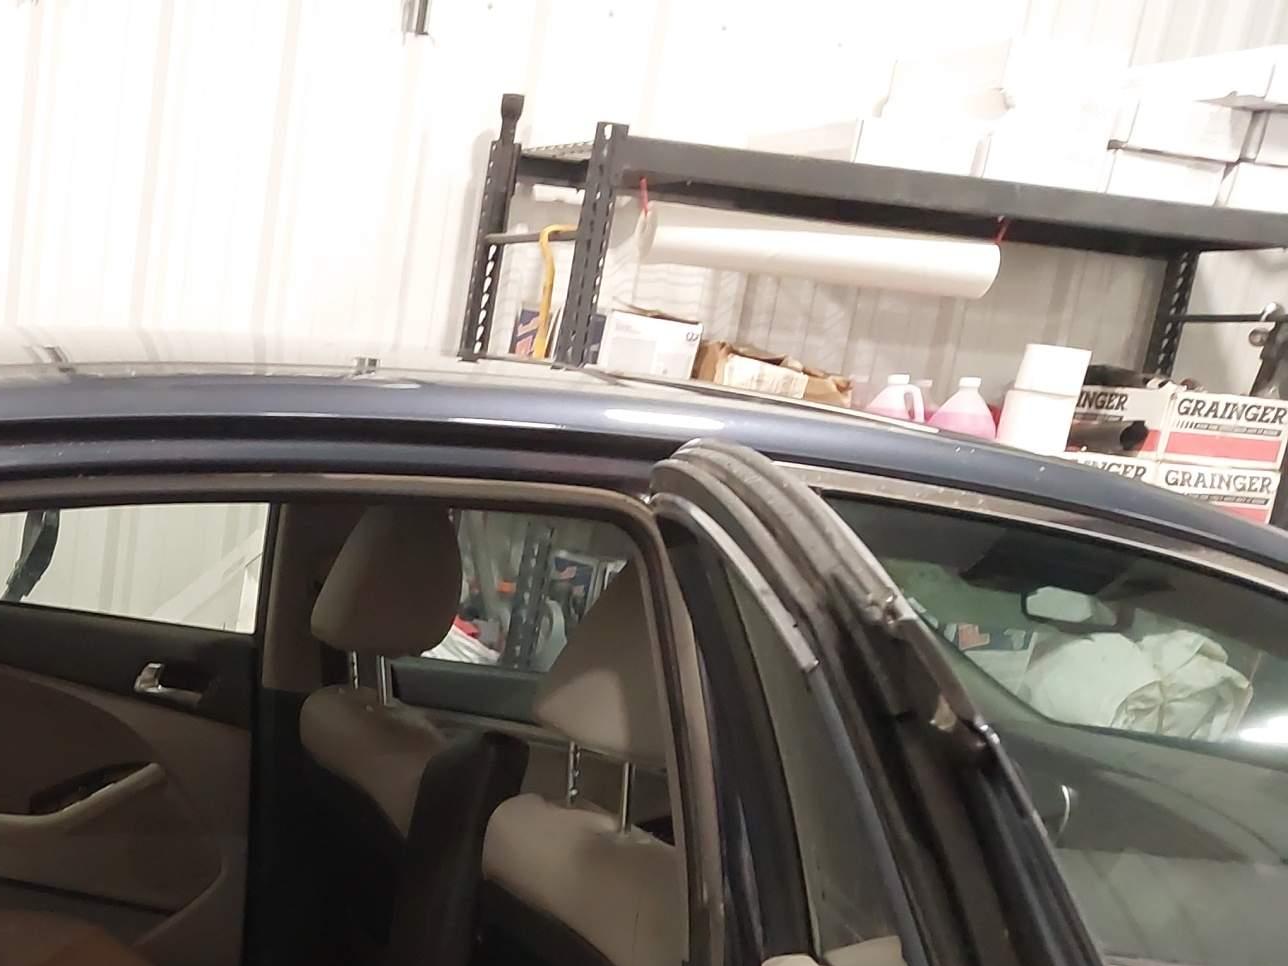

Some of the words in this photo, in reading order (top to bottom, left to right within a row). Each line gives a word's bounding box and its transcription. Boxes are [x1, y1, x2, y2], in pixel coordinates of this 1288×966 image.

[1077, 391, 1128, 411] INGER
[1177, 398, 1287, 424] GRAINGER
[1165, 469, 1272, 494] GRAINGER
